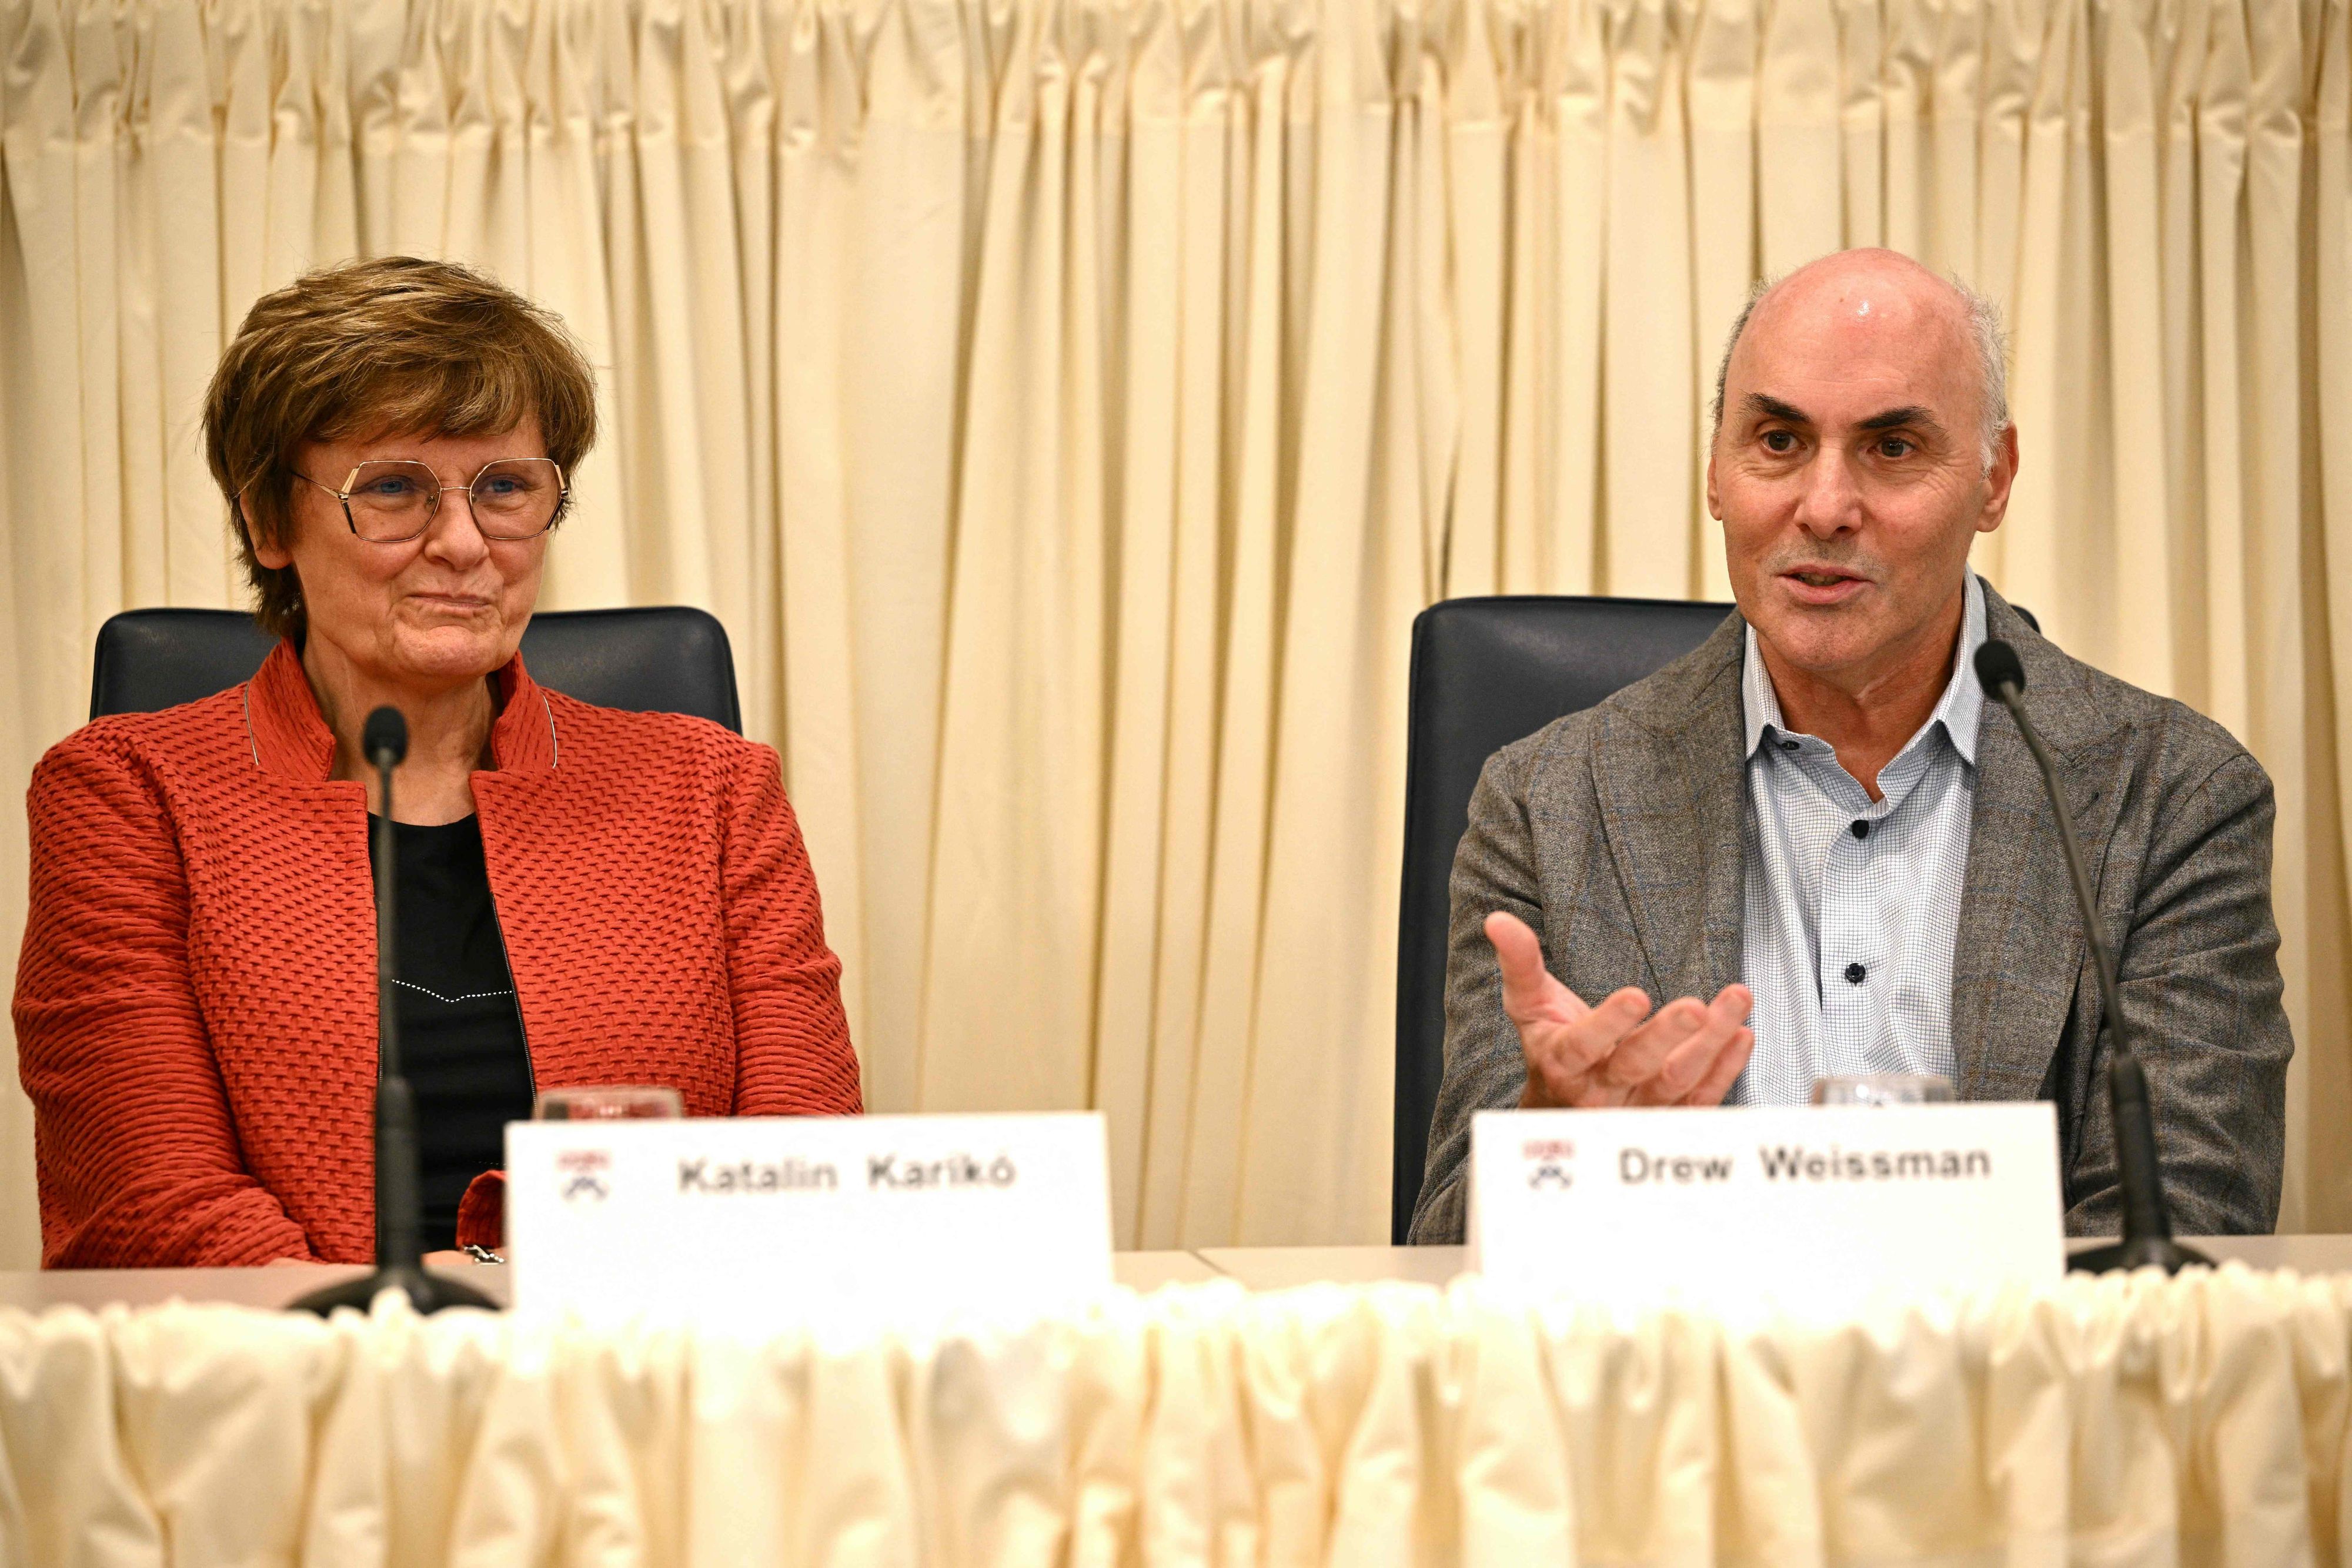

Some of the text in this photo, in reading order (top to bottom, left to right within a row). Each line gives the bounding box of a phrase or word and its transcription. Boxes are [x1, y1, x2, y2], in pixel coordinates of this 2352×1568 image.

[679, 1152, 1015, 1192] Katalin Karikó
[1619, 1145, 1992, 1183] Drew Weissman
